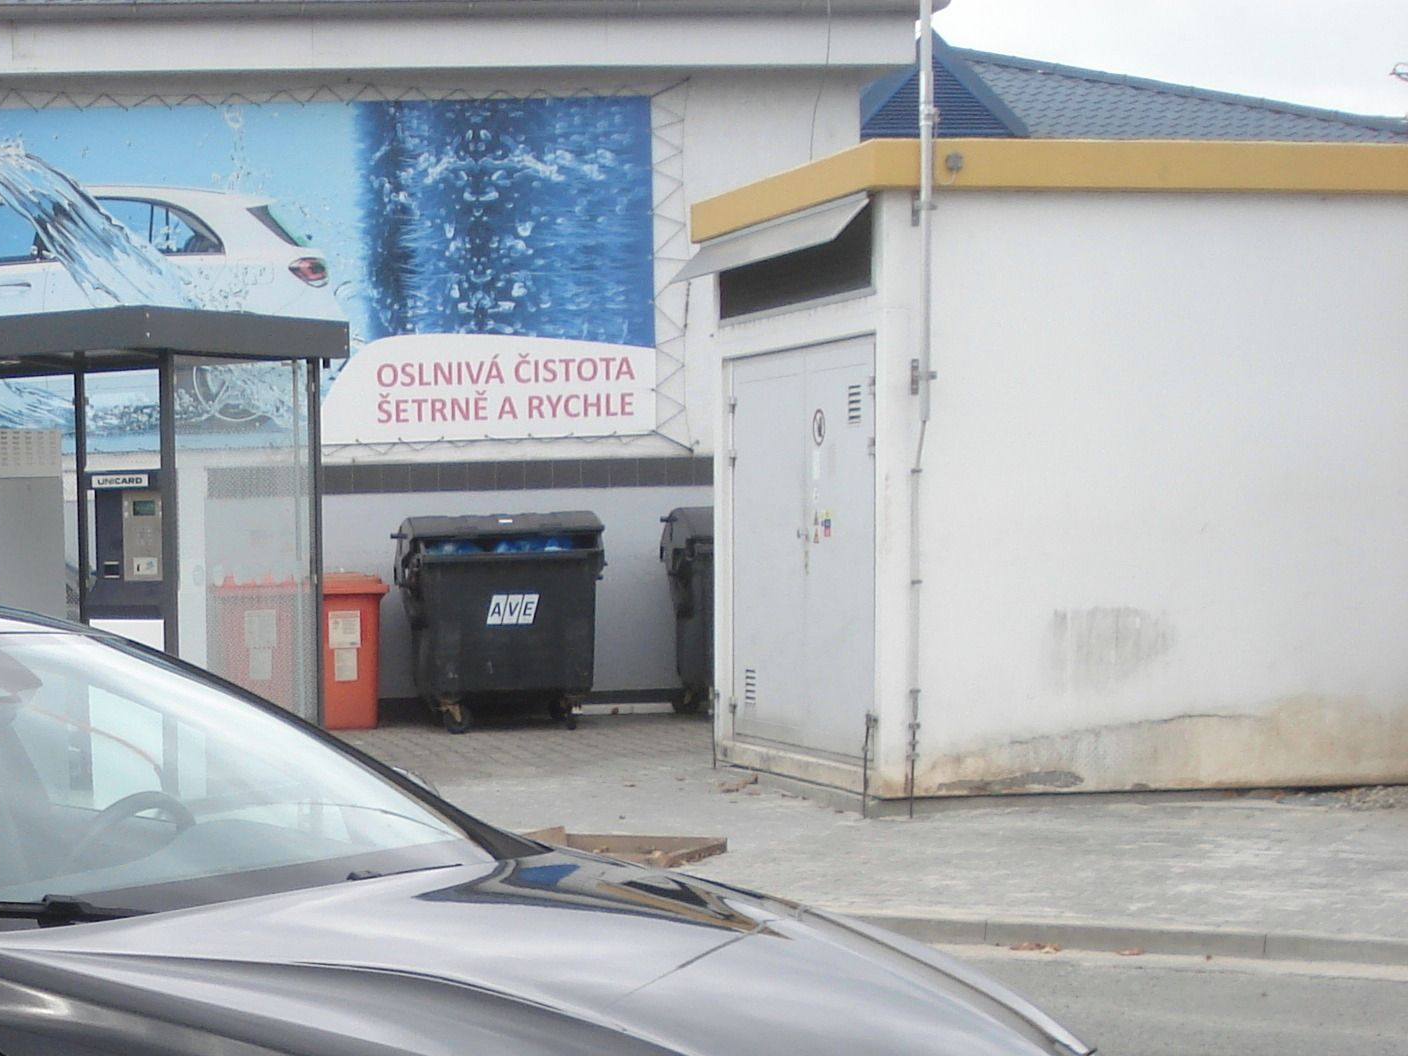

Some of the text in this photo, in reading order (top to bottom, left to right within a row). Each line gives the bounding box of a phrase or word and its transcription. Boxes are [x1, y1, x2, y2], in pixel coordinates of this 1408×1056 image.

[376, 353, 635, 388] OSLNIVÁ ČISTOTA
[377, 391, 635, 424] ŠETRNĚ A RYCHLE
[97, 477, 143, 486] UNICARD
[490, 601, 535, 617] AVE
